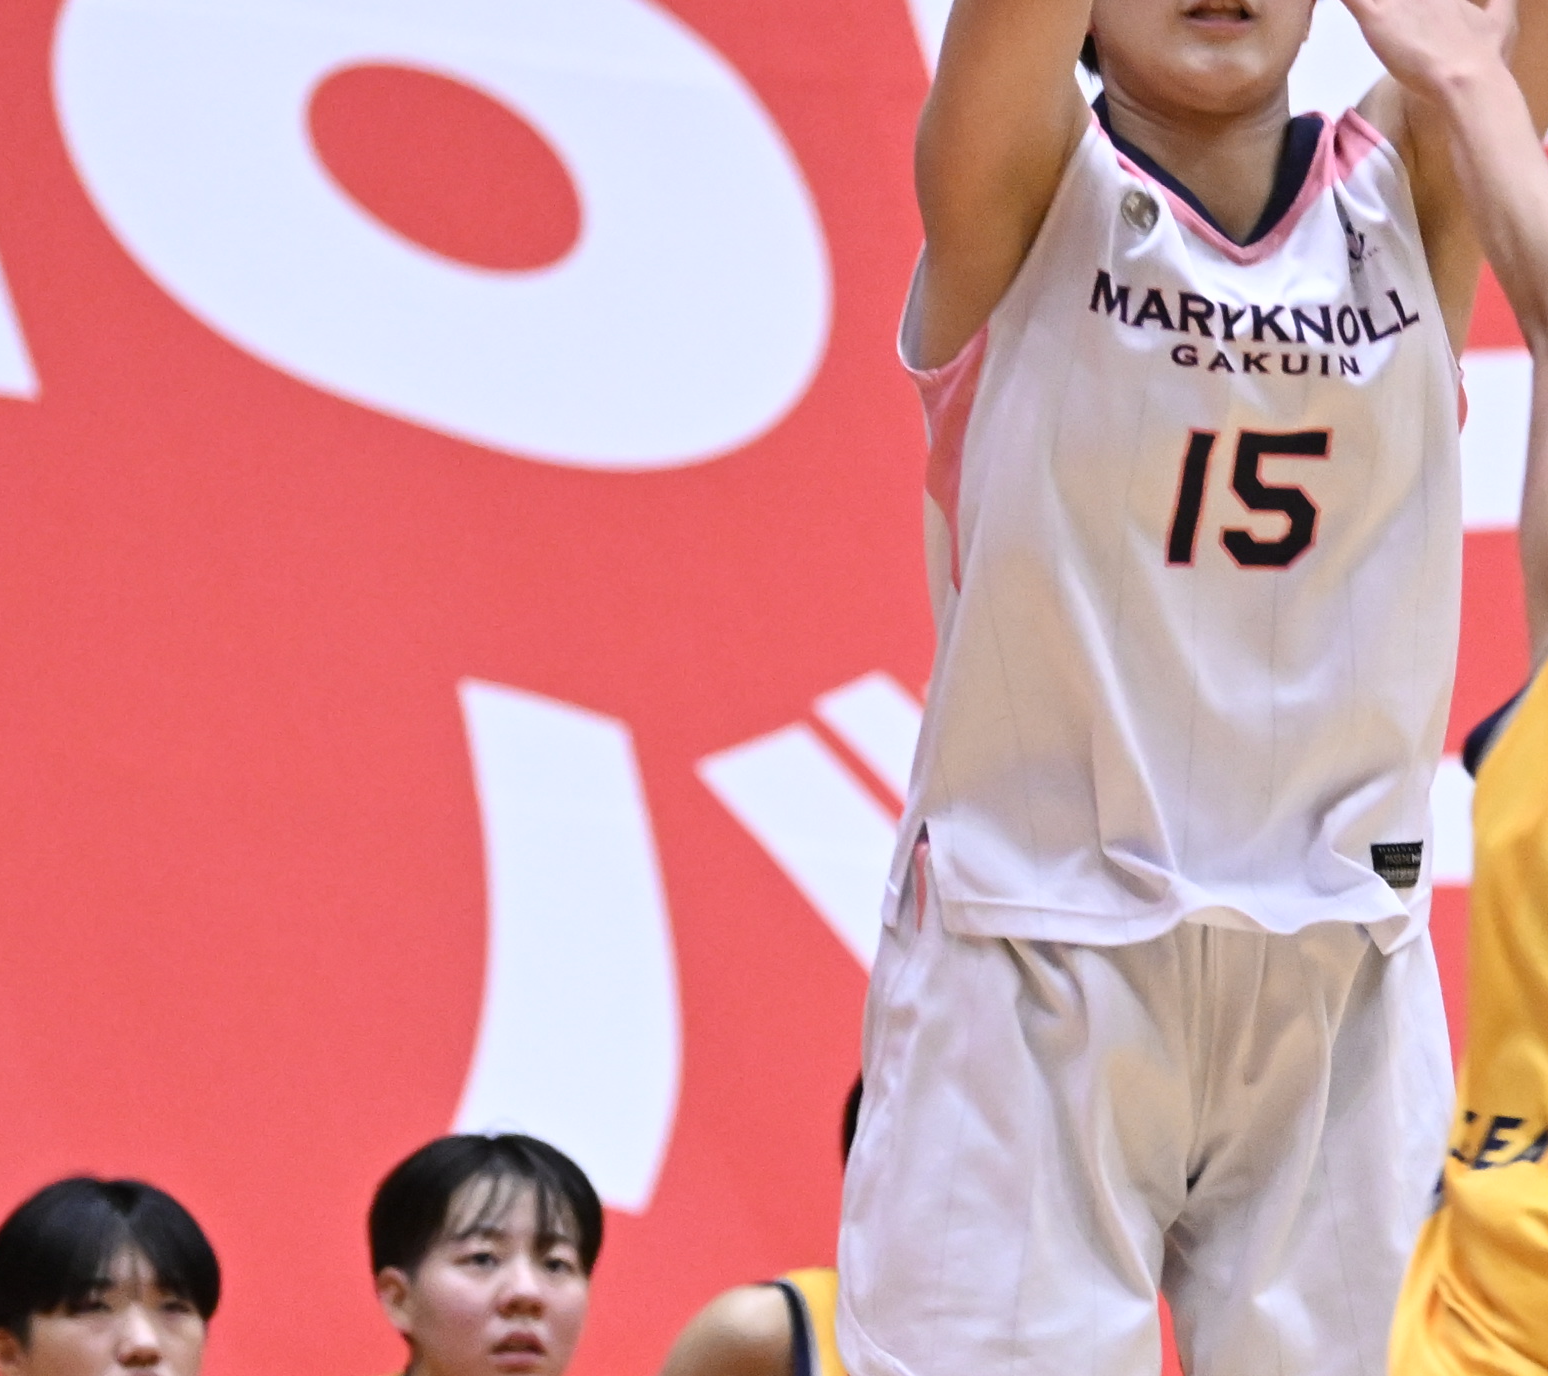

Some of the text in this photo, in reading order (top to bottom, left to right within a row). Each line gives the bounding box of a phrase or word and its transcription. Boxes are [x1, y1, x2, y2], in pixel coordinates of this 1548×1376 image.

[1089, 269, 1420, 346] MARYKNOLL
[1171, 344, 1361, 376] GAKUIN
[1164, 427, 1333, 570] 15
